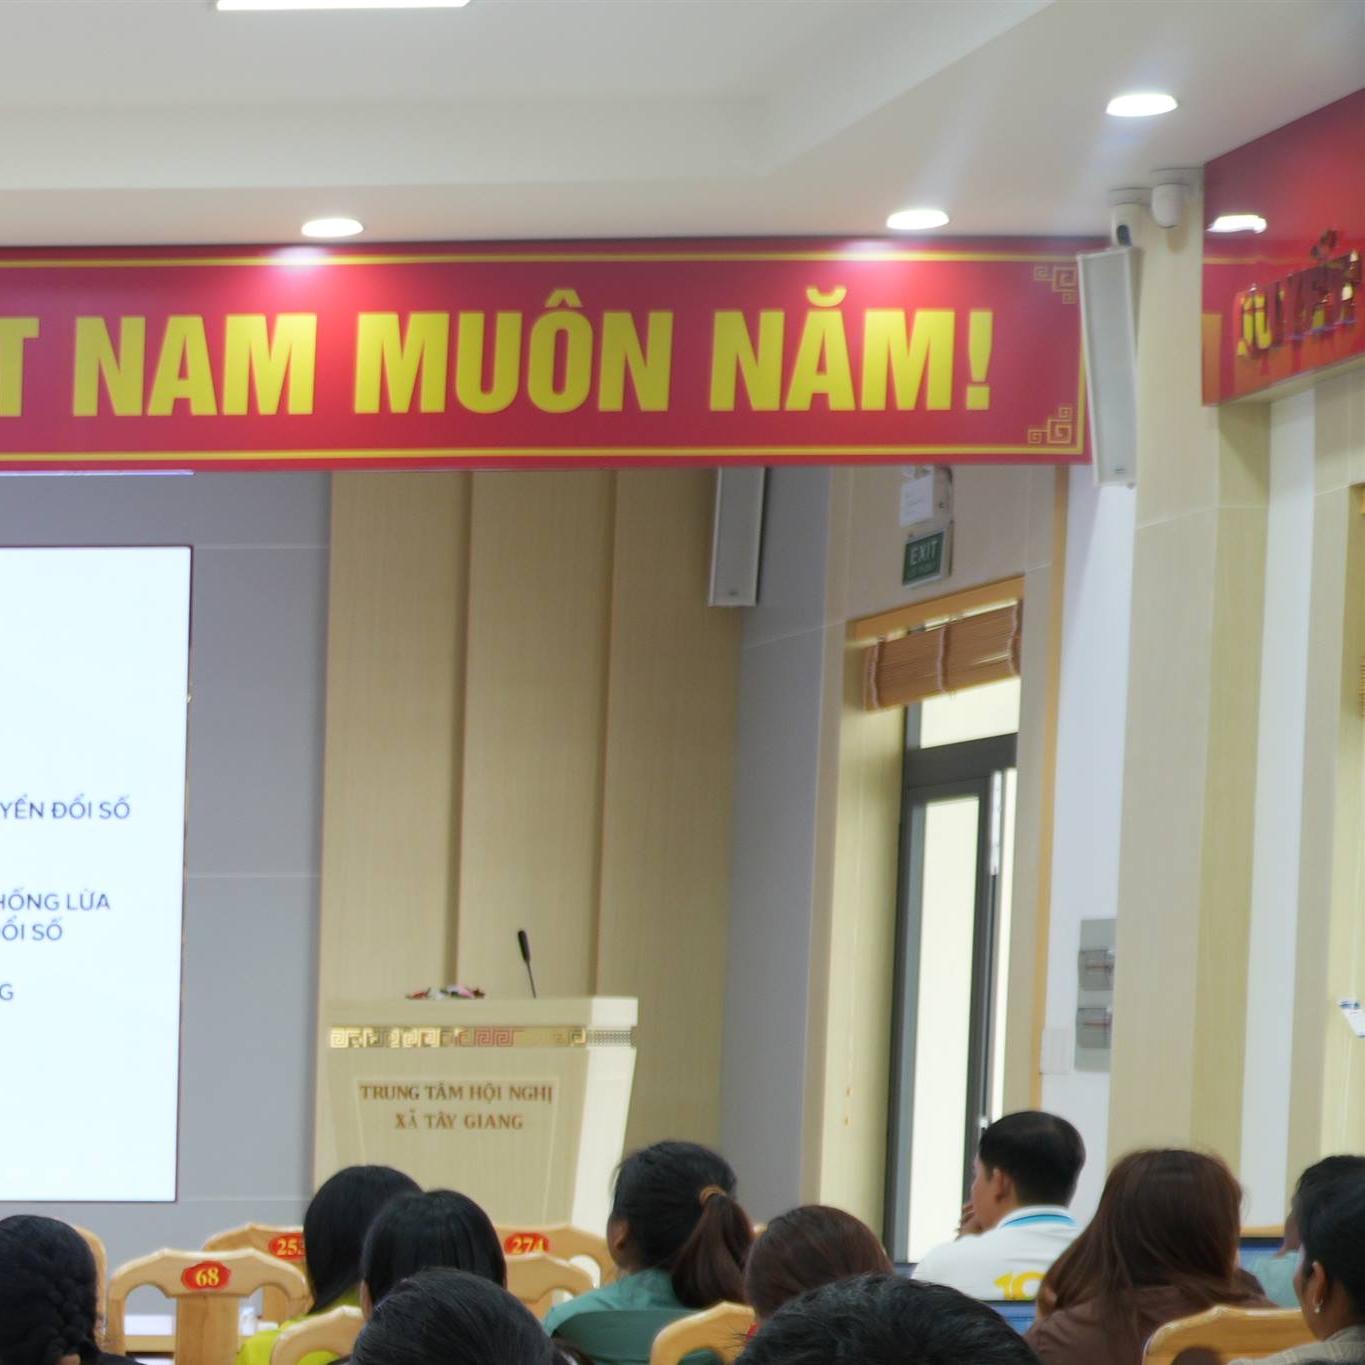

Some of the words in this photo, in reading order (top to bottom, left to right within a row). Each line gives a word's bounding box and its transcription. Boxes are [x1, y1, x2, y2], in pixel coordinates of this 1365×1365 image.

[73, 312, 319, 416] NAM
[353, 291, 672, 414] MUÔN
[709, 286, 994, 412] NĂM!
[910, 540, 938, 565] EXIT
[51, 795, 92, 819] ĐỔI
[99, 796, 130, 819] SỐ
[67, 889, 110, 910] LỪA
[32, 917, 63, 940] SỐ
[360, 1085, 419, 1101] TRUNG
[424, 1083, 464, 1101] TÂM
[469, 1082, 502, 1104] HỘI
[509, 1085, 553, 1104] NGHỊ
[423, 1111, 457, 1129] TÂY
[464, 1113, 523, 1130] GIANG
[195, 1266, 220, 1287] 68
